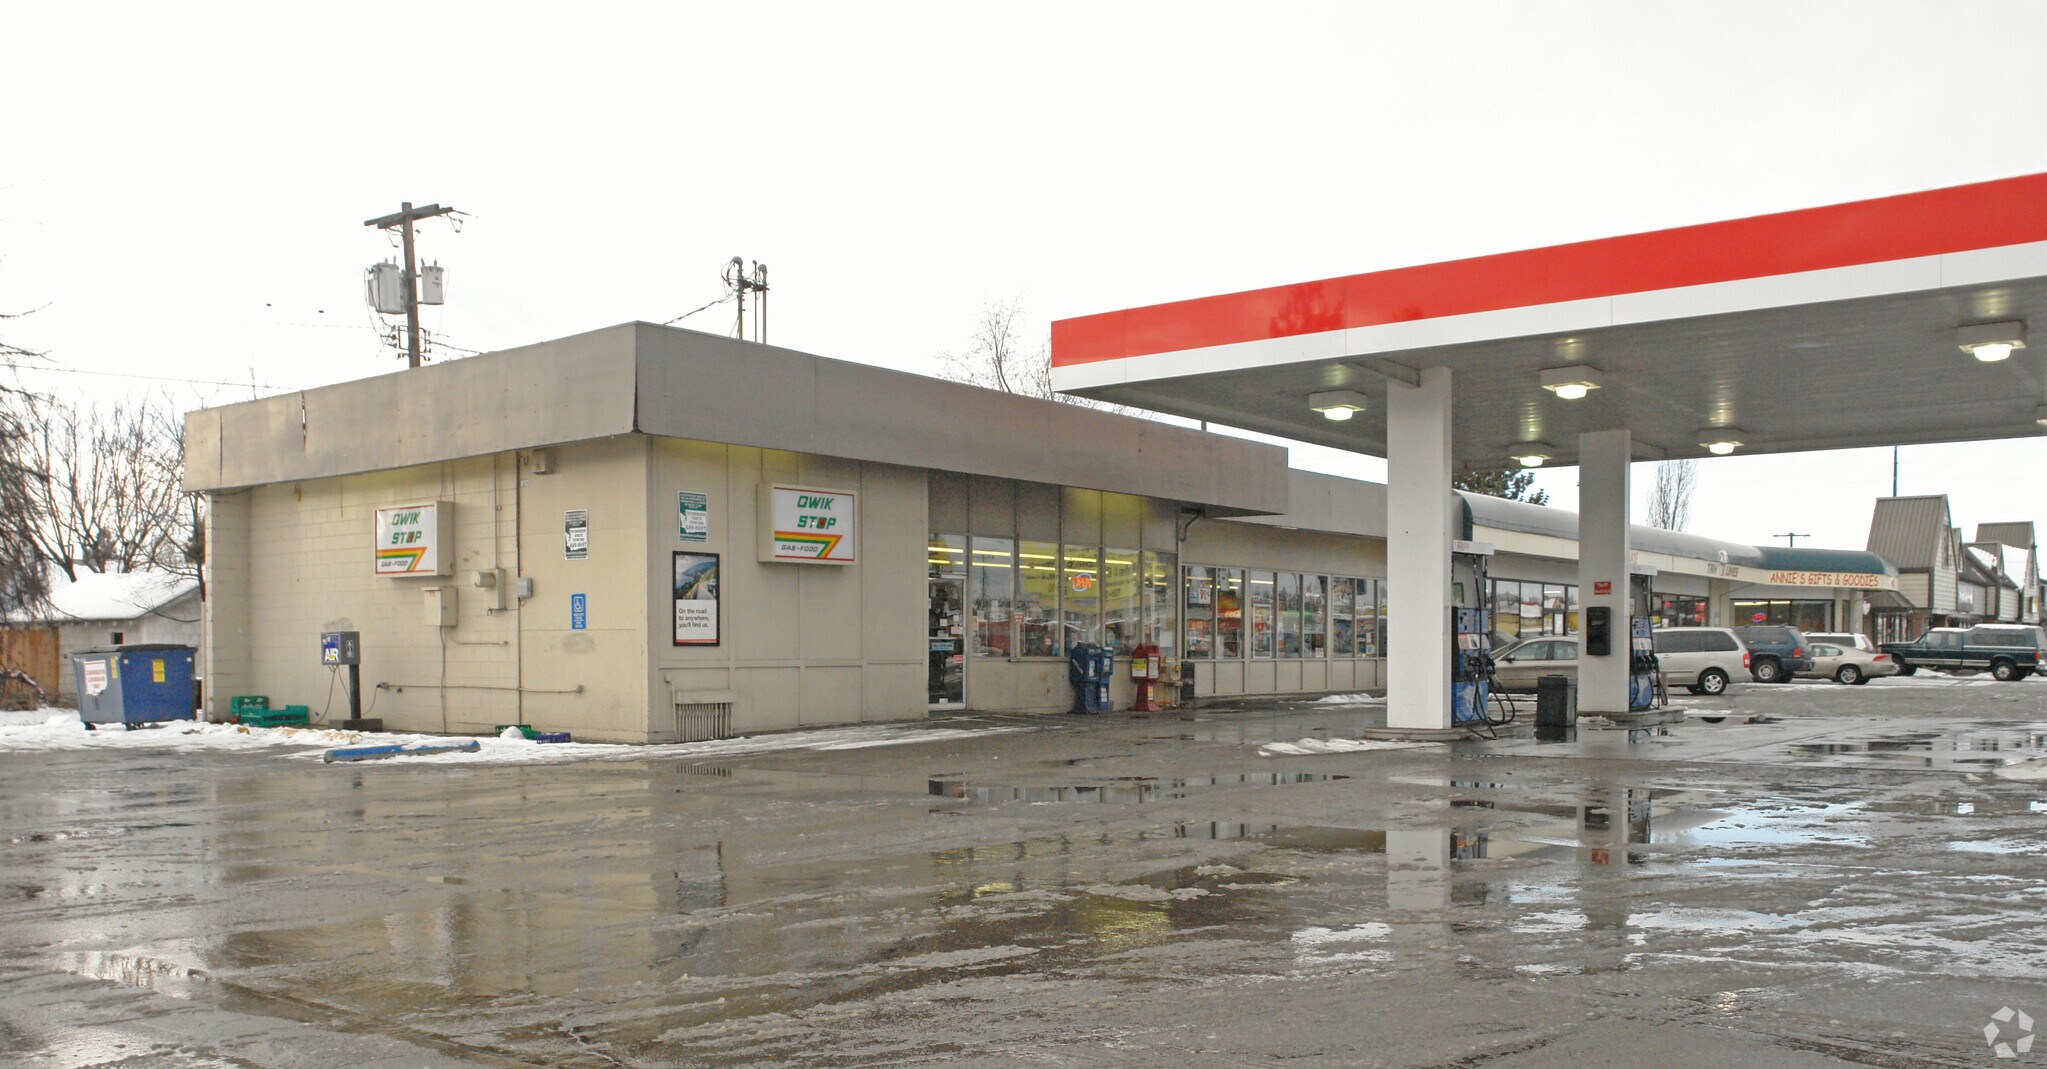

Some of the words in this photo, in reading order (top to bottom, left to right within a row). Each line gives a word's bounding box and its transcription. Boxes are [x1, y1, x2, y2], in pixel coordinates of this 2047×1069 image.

[797, 495, 834, 510] QWIK
[392, 511, 421, 525] QWIK
[797, 515, 836, 529] STOP
[391, 530, 422, 544] STOP
[781, 544, 818, 552] GAS-FOOD
[1072, 576, 1092, 589] OPEN
[1770, 572, 1805, 585] ANNIE'S
[1808, 573, 1832, 585] GIFTS
[1835, 574, 1840, 585] &
[1843, 574, 1879, 587] GOODIES
[325, 648, 339, 661] AIR
